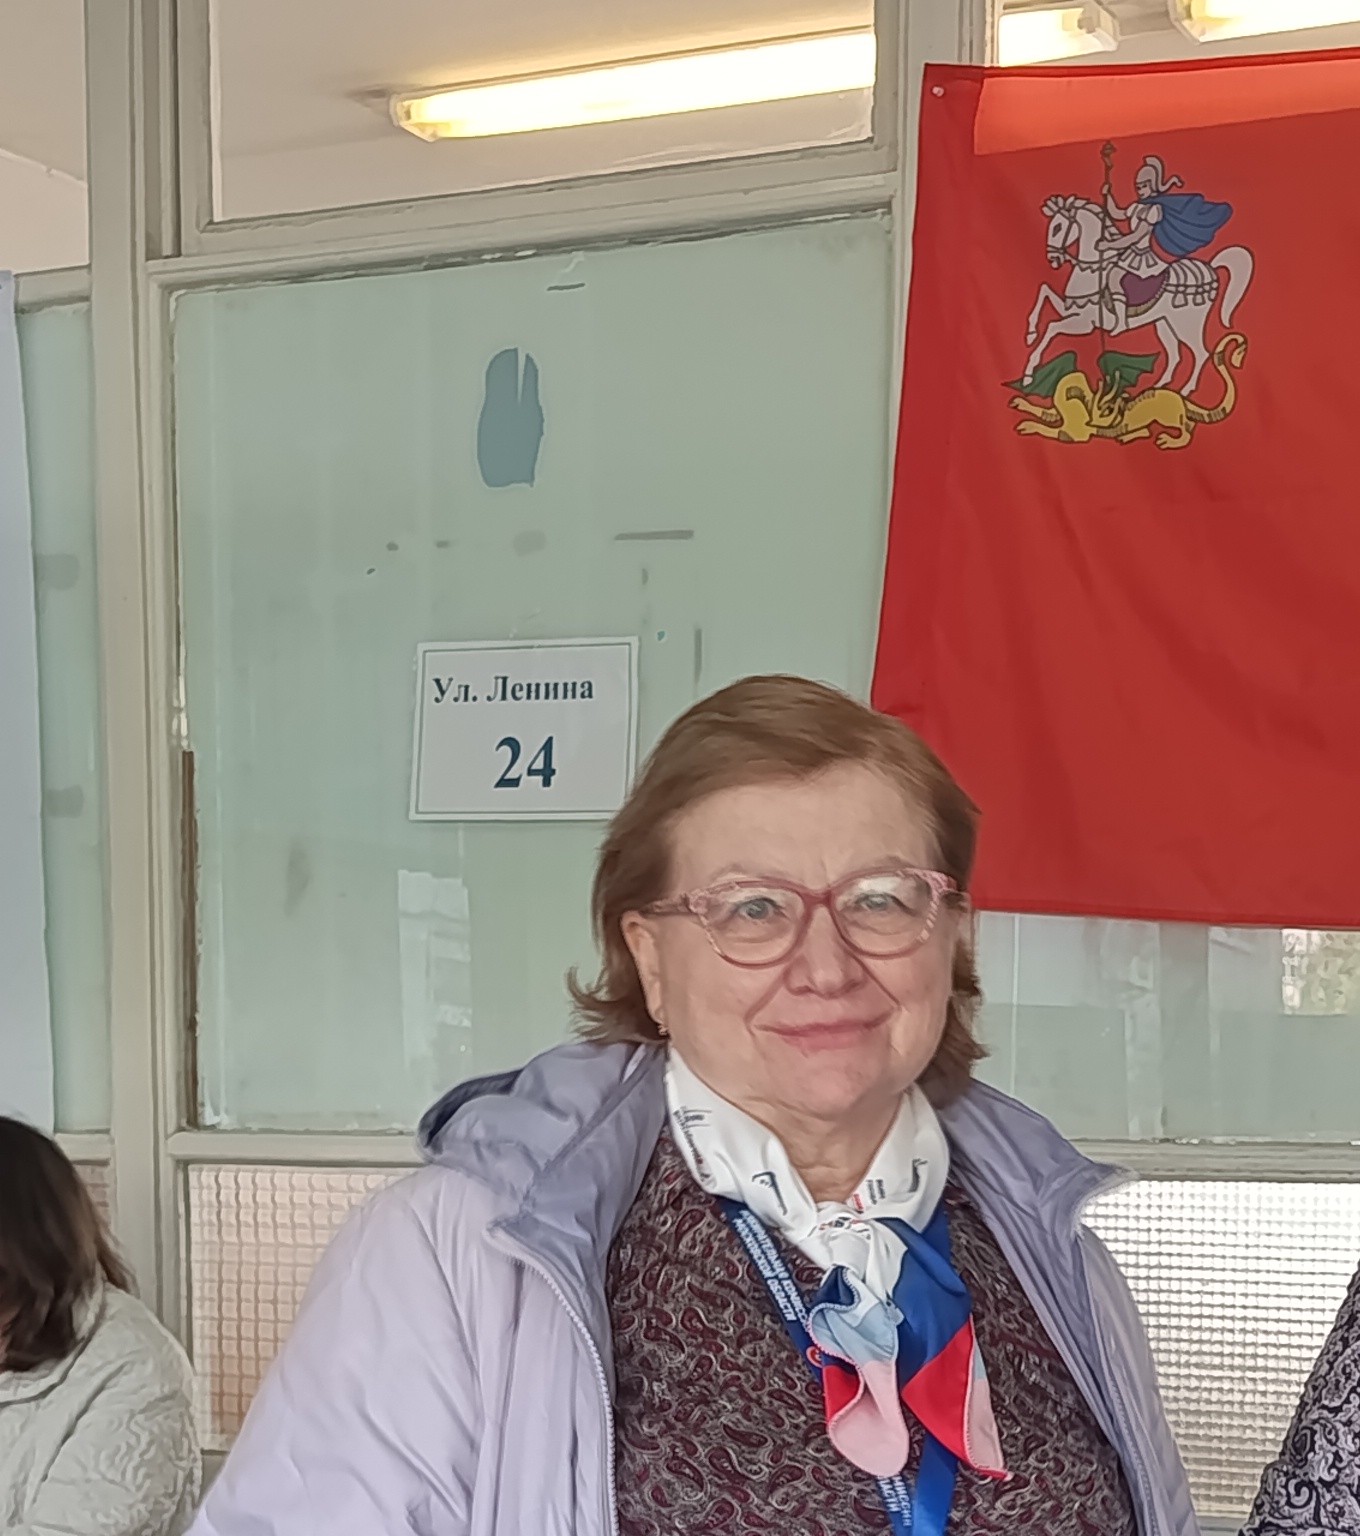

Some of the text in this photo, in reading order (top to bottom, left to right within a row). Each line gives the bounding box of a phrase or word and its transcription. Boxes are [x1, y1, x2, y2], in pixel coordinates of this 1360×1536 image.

[432, 676, 594, 703] Ул. Ленина
[494, 736, 556, 788] 24
